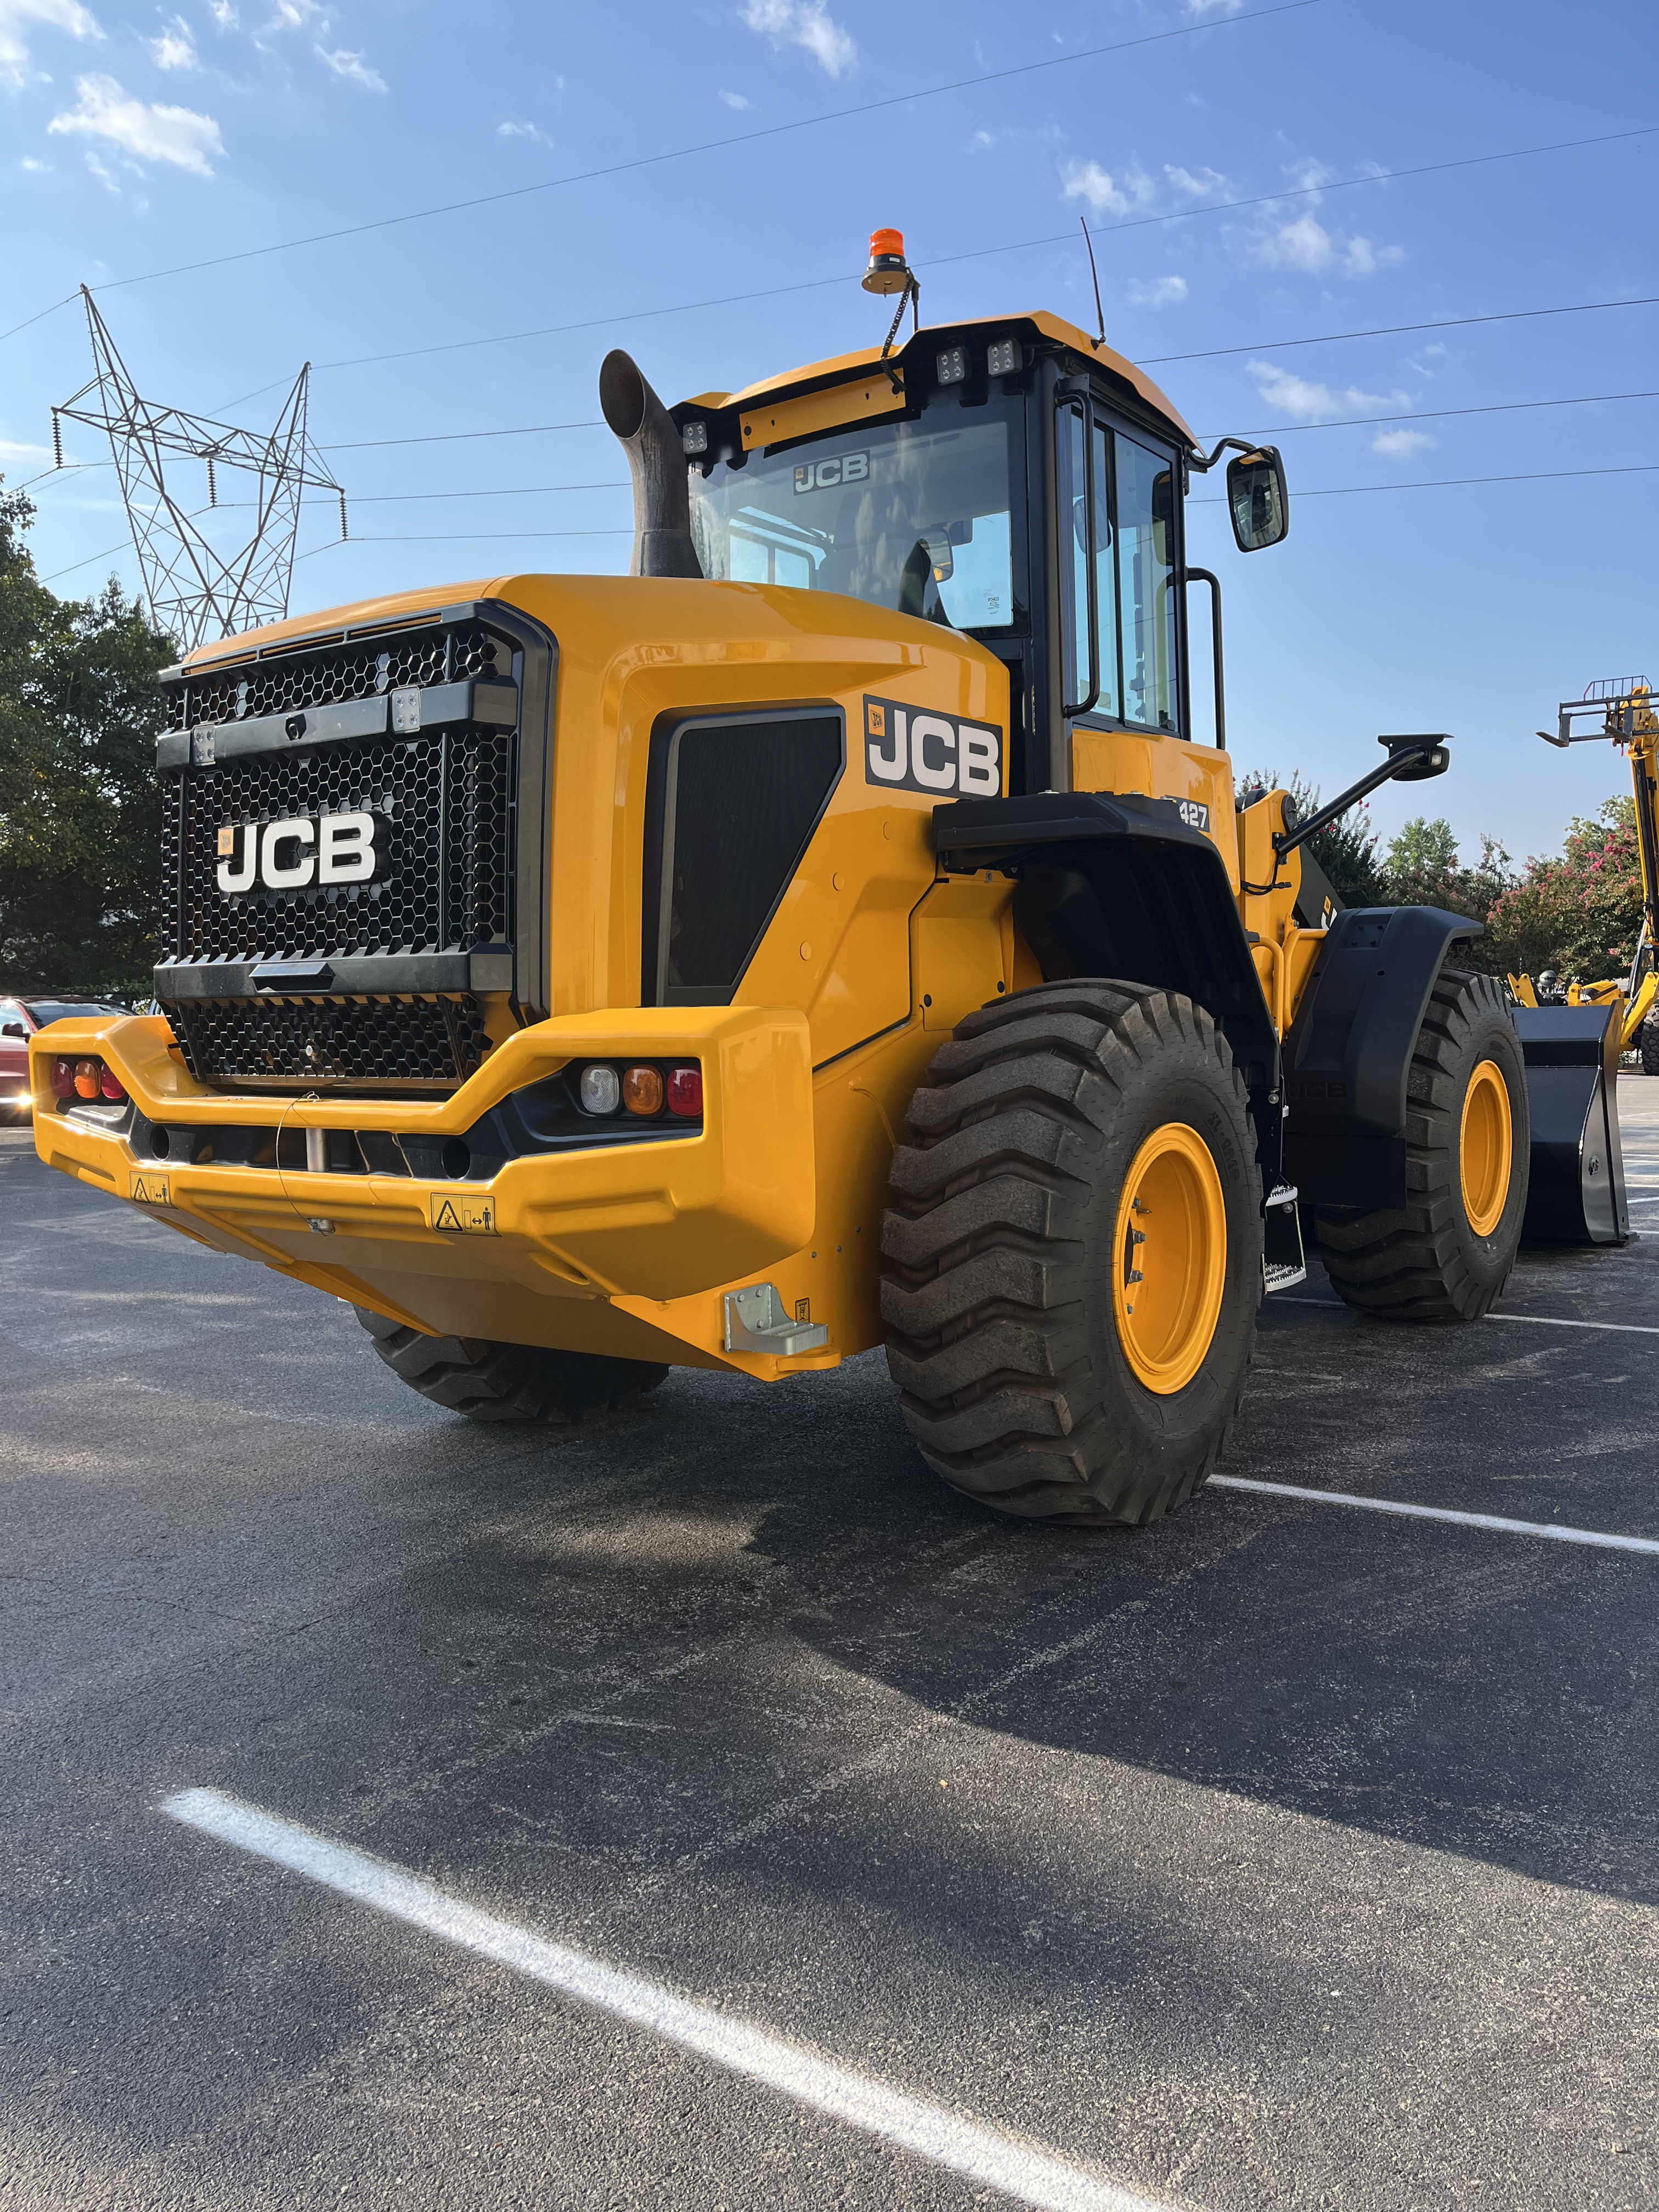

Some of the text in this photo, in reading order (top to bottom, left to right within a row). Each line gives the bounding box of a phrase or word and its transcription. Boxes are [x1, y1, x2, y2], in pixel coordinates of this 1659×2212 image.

[795, 454, 868, 493] JCB
[869, 709, 1000, 797] JCB
[1179, 802, 1207, 828] 427
[217, 812, 375, 892] JCB
[1288, 1081, 1347, 1099] JCB
